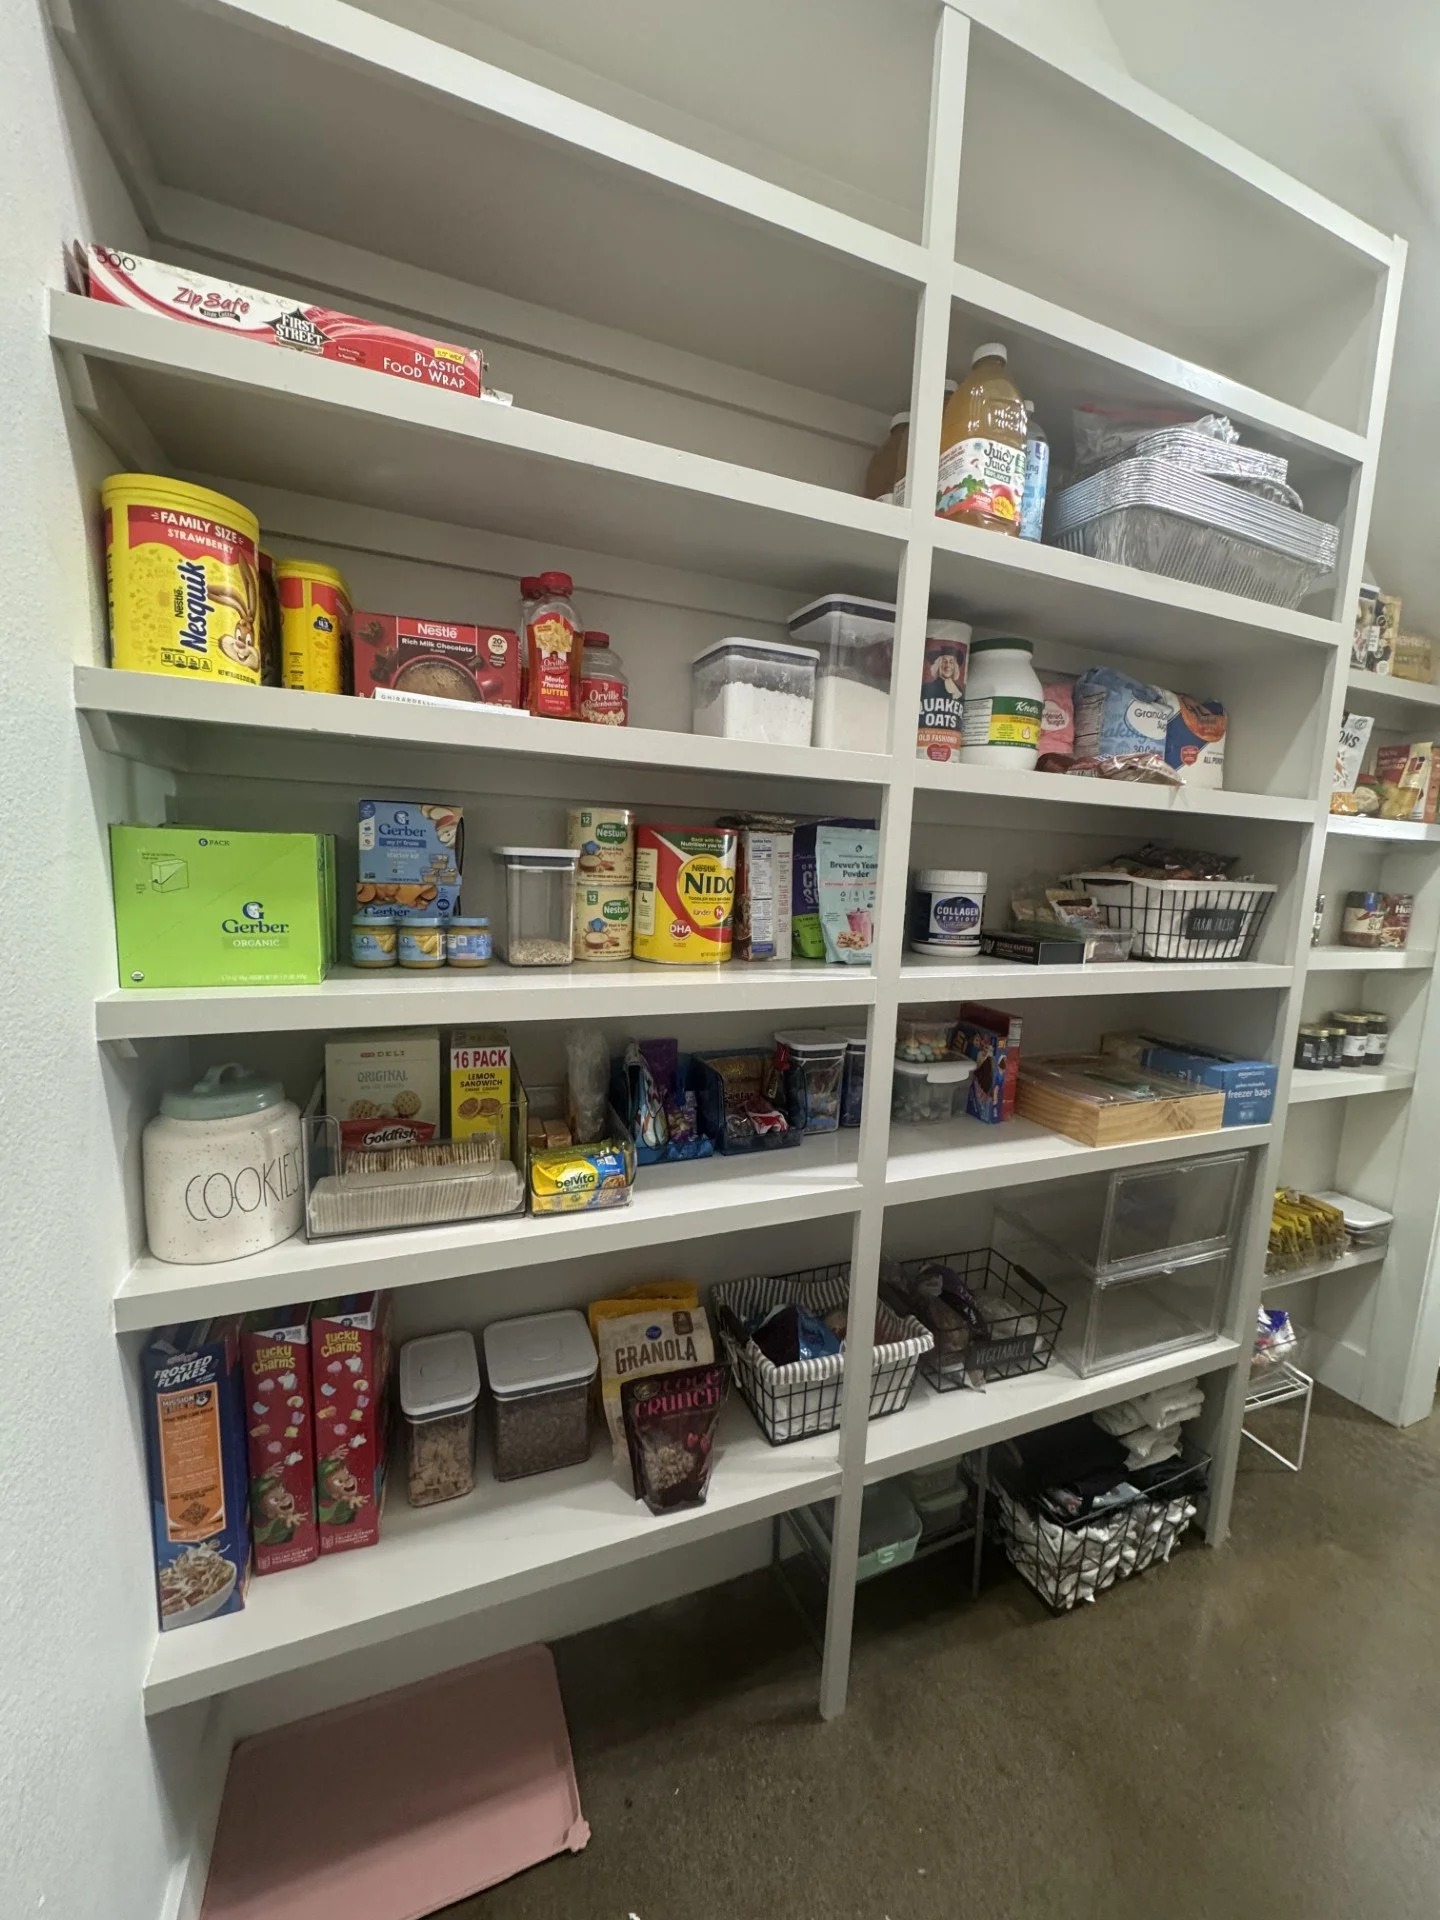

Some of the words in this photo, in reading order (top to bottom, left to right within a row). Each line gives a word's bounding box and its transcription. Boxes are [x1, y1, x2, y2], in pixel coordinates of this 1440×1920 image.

[173, 287, 203, 310] Zip
[204, 292, 250, 314] Safe
[281, 312, 316, 333] FIRST
[275, 324, 323, 347] STREET
[414, 352, 465, 377] PLASTIC
[383, 357, 422, 379] FOOD
[427, 368, 466, 390] WRAP
[984, 442, 1015, 465] Juicy
[985, 456, 1012, 474] Juice
[160, 511, 211, 534] FAMILY
[214, 525, 237, 544] SIZE
[167, 528, 234, 555] STRAWBERRY
[177, 561, 215, 654] Nesquik
[401, 637, 418, 646] Rich
[419, 640, 435, 648] Milk
[436, 642, 473, 654] Chocolate
[543, 658, 565, 668] Orville
[541, 681, 569, 690] Theater
[544, 674, 565, 684] Movie
[541, 687, 569, 697] BUTTER
[589, 690, 619, 701] Orville
[925, 713, 957, 728] OATS
[918, 733, 931, 741] OLD
[378, 824, 426, 838] Gerber
[596, 828, 627, 838] Nestum
[209, 839, 230, 847] PACK
[680, 841, 707, 849] Nutrition
[829, 860, 860, 869] Brewer's
[842, 870, 870, 878] Powder
[684, 871, 735, 895] NIDO
[588, 894, 597, 902] 12
[364, 906, 411, 917] Gerber
[936, 906, 979, 916] COLLAGEN
[221, 918, 288, 934] Gerber
[669, 924, 692, 934] DHA
[233, 938, 280, 947] ORGANIC
[453, 1051, 469, 1068] 16
[473, 1050, 508, 1068] PACK
[357, 1069, 409, 1083] ORIGINAL
[460, 1079, 503, 1088] SANDWICH
[1228, 1088, 1252, 1099] freezer
[1254, 1087, 1272, 1098] bags
[362, 1127, 417, 1146] Goldfish
[185, 1146, 300, 1222] COOKIES
[555, 1171, 595, 1189] belVita
[321, 1342, 362, 1358] Charms
[615, 1336, 698, 1375] GRANOLA
[154, 1355, 213, 1381] FROSTED
[252, 1357, 296, 1375] Charms
[157, 1367, 207, 1388] FLAKES
[162, 1395, 195, 1408] MISSION
[635, 1387, 721, 1417] CRUNCH
